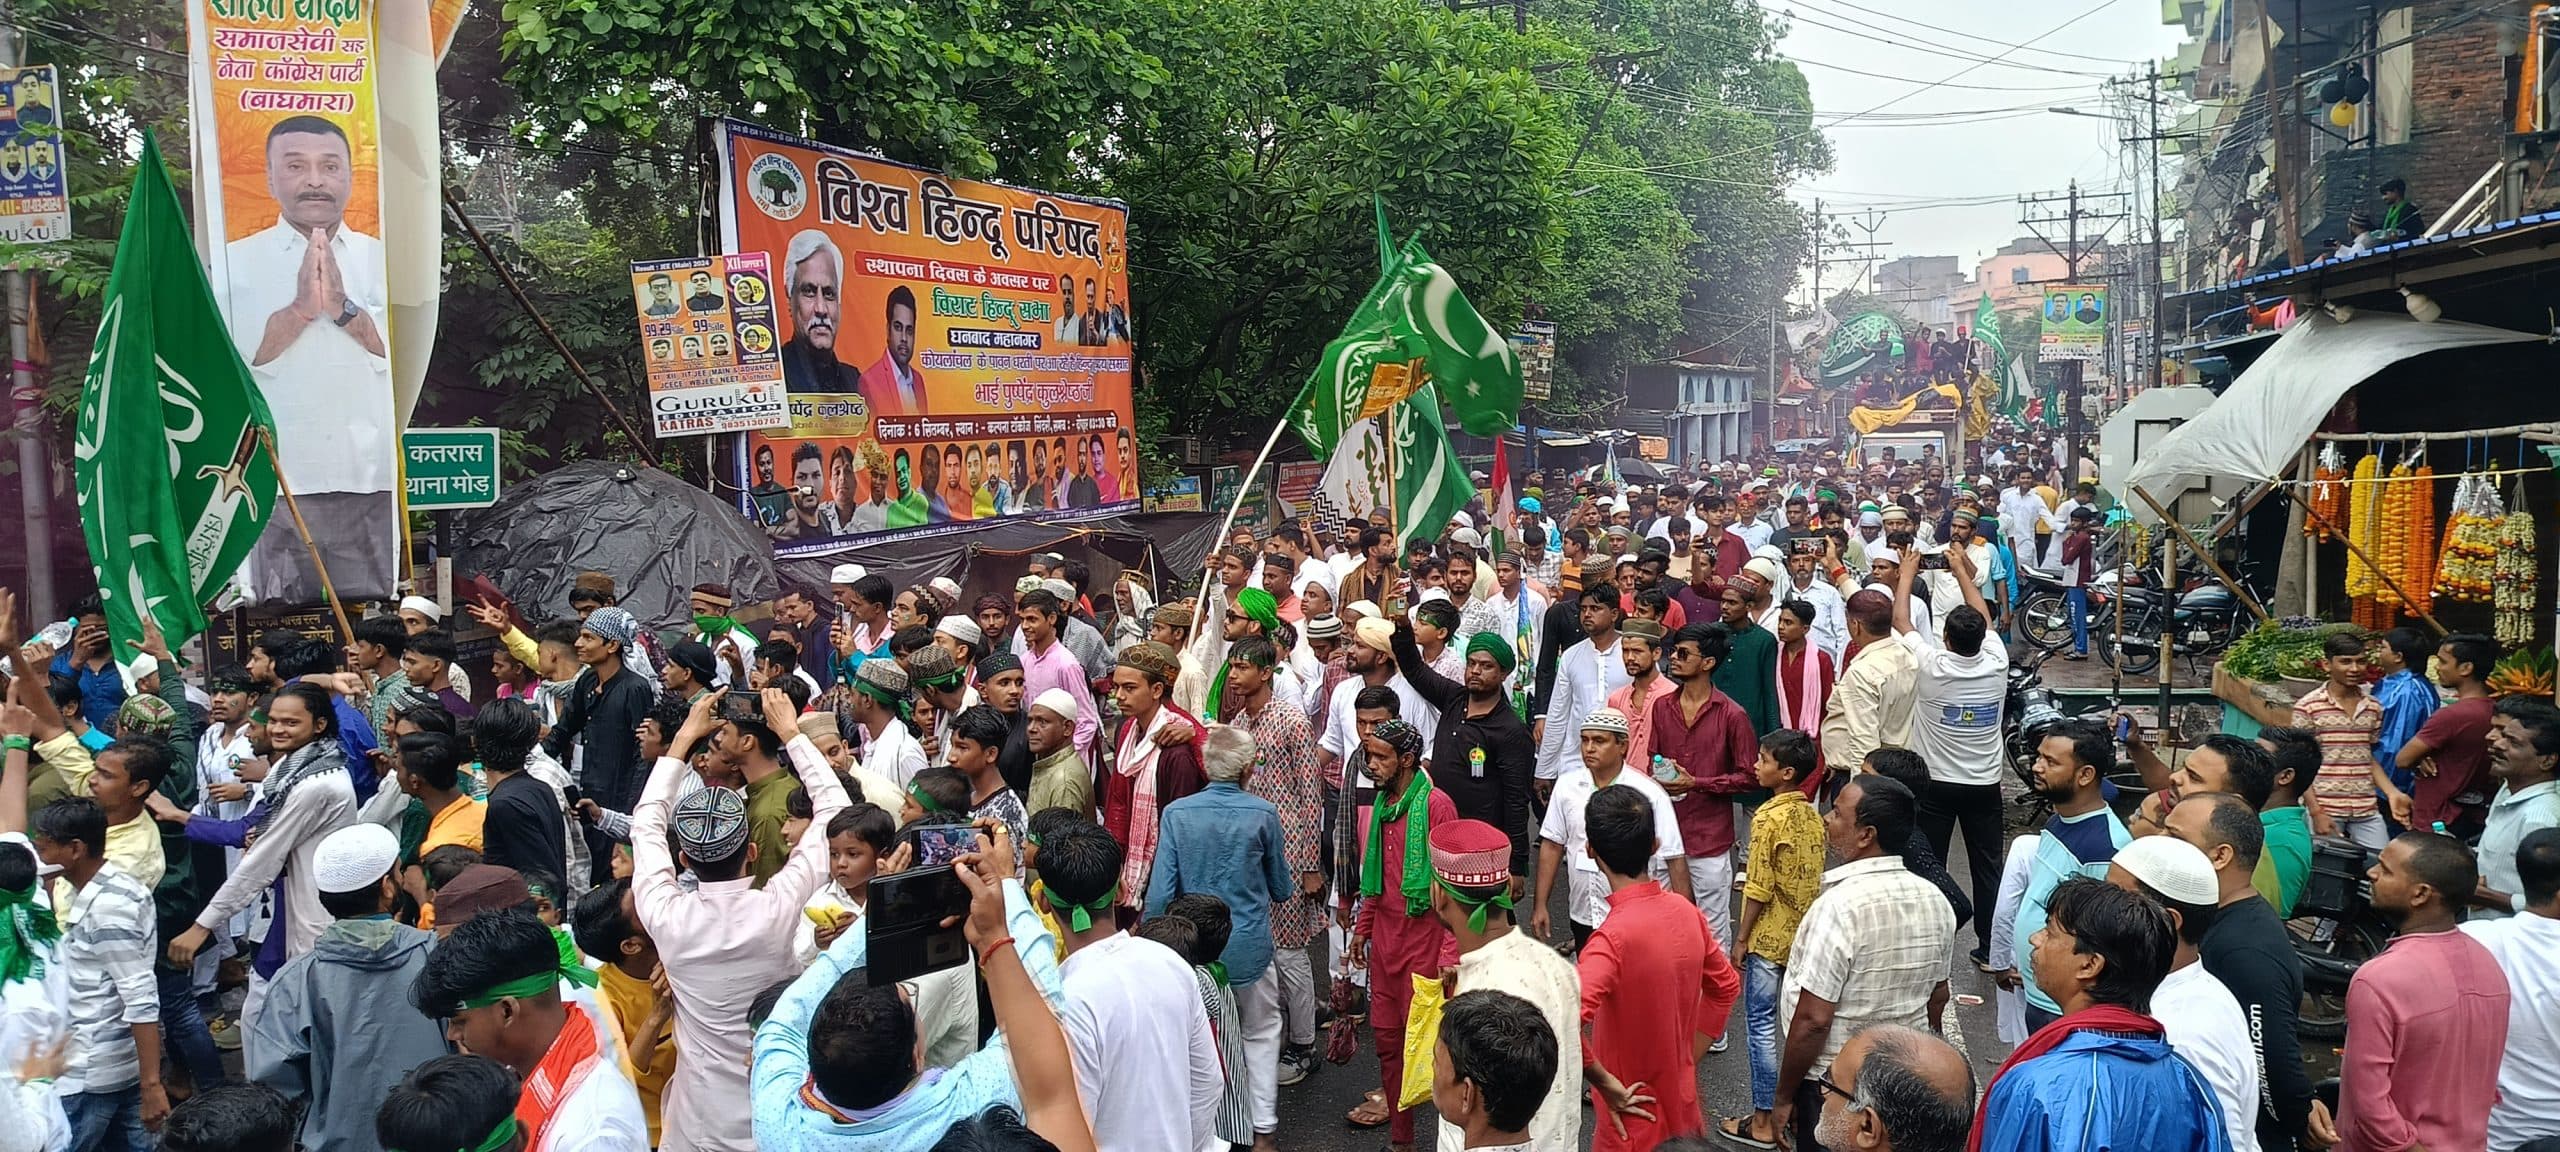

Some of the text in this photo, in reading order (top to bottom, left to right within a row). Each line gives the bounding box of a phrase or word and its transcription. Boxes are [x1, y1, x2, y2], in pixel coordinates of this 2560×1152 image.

[215, 26, 366, 53] समाजसेवी सह
[216, 53, 255, 79] नेता
[328, 57, 367, 82] पार्टी
[240, 90, 355, 111] (बाघमारा)
[817, 159, 911, 233] विश्व
[920, 178, 1010, 261] हिन्दू
[726, 257, 741, 270] XII
[865, 258, 1051, 291] स्थापना दिवस के अवसर पर
[932, 286, 1051, 329] विराट हिन्दू सभा
[994, 333, 1039, 348] महानगर
[975, 377, 1000, 404] भाई
[660, 417, 714, 431] KATRAS
[662, 404, 778, 420] EDUCATION
[877, 418, 906, 440] दिनांक
[914, 423, 920, 437] 6
[408, 445, 484, 463] कतरास
[450, 468, 490, 496] मोड़
